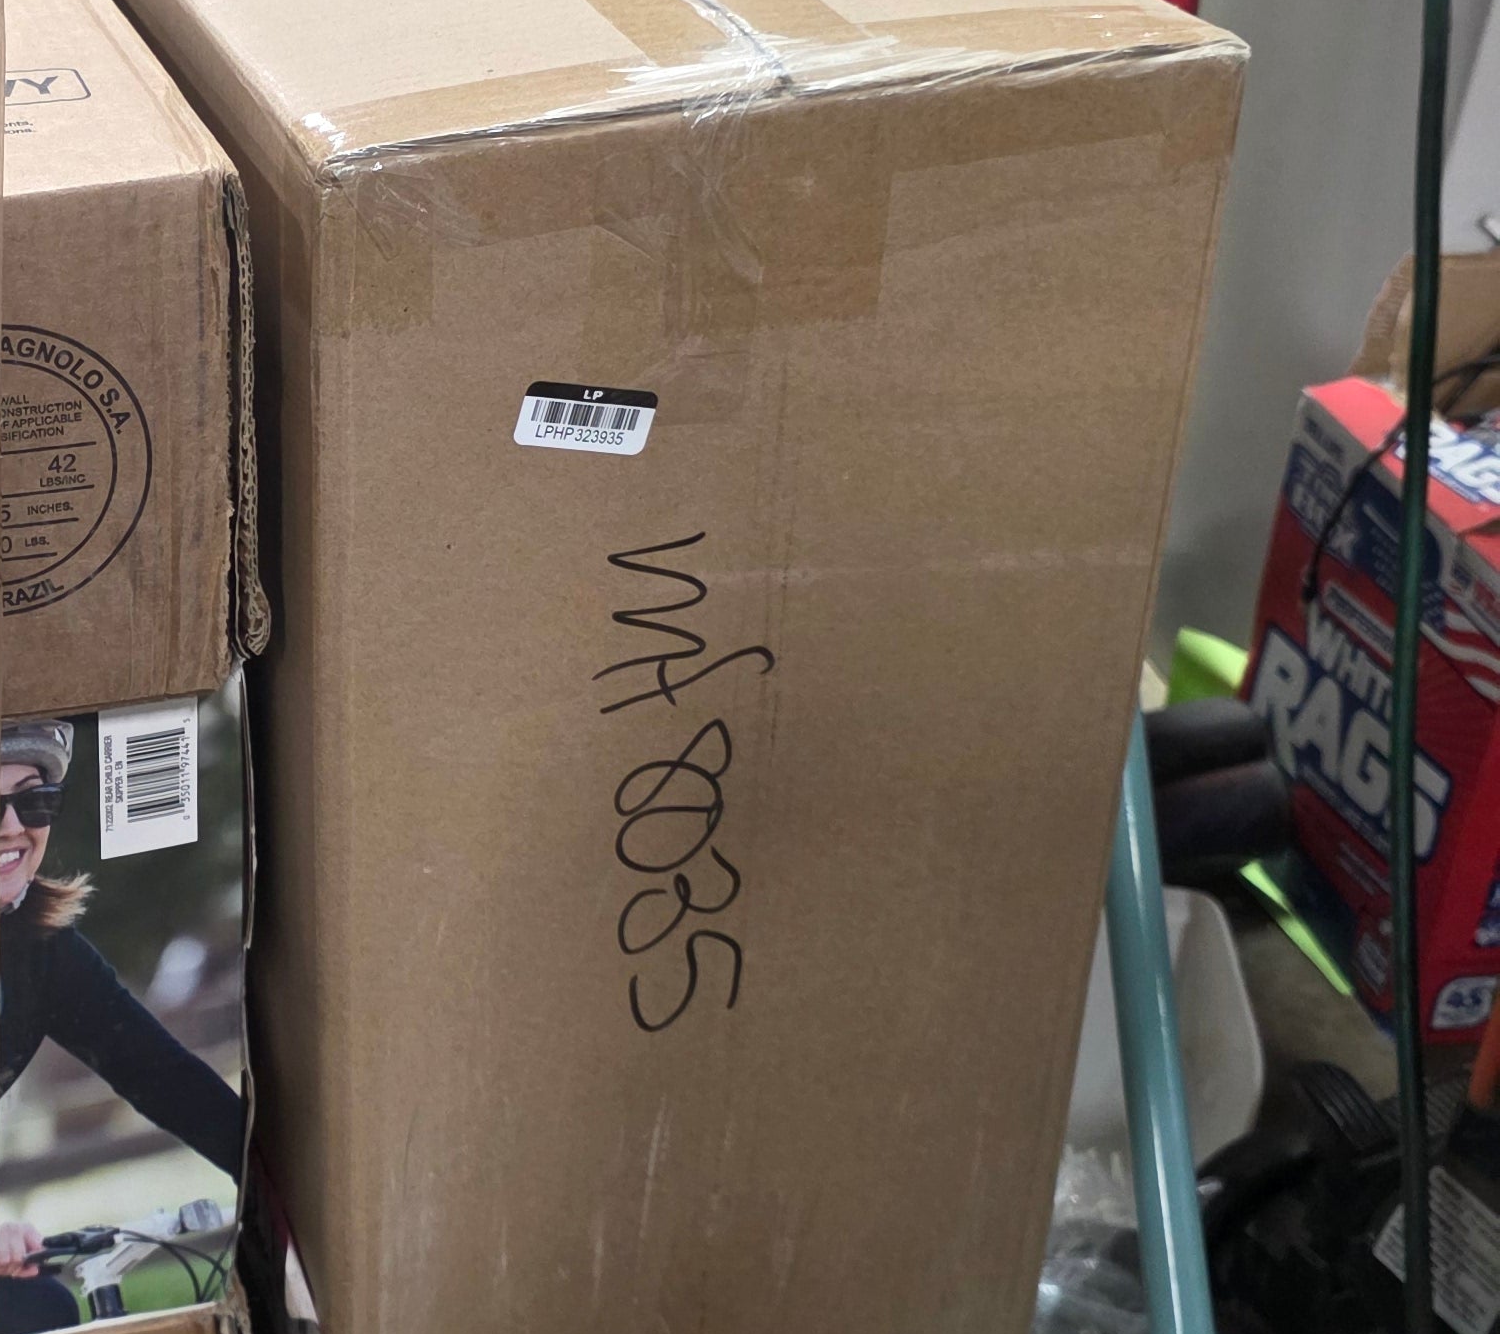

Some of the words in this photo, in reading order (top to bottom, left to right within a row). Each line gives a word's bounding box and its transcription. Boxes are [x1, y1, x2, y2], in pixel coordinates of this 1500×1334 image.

[1, 336, 104, 390] AGNOLO
[583, 390, 604, 400] LP
[12, 412, 82, 429] APPLICABLE
[1, 426, 64, 442] SIFICATION
[535, 424, 624, 445] LPHP323935
[48, 454, 77, 473] 42
[27, 501, 74, 515] INCHES.
[1306, 603, 1395, 719] WHIT
